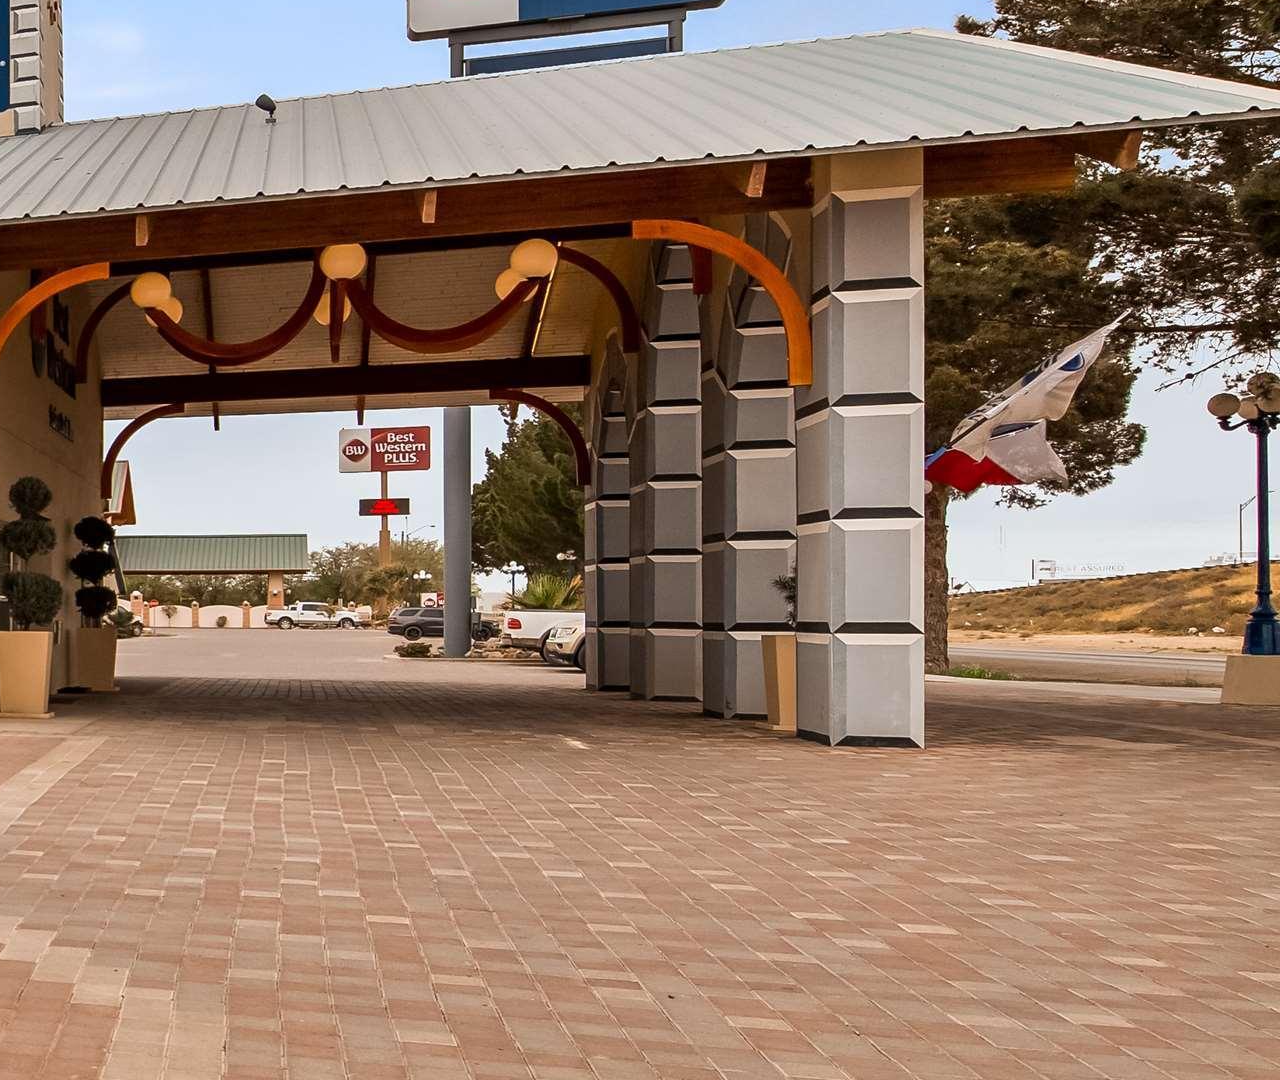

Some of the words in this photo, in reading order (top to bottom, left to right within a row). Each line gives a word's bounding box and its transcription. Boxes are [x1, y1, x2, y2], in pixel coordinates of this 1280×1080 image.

[387, 432, 414, 442] Best
[345, 445, 366, 456] BW
[375, 443, 426, 453] Western
